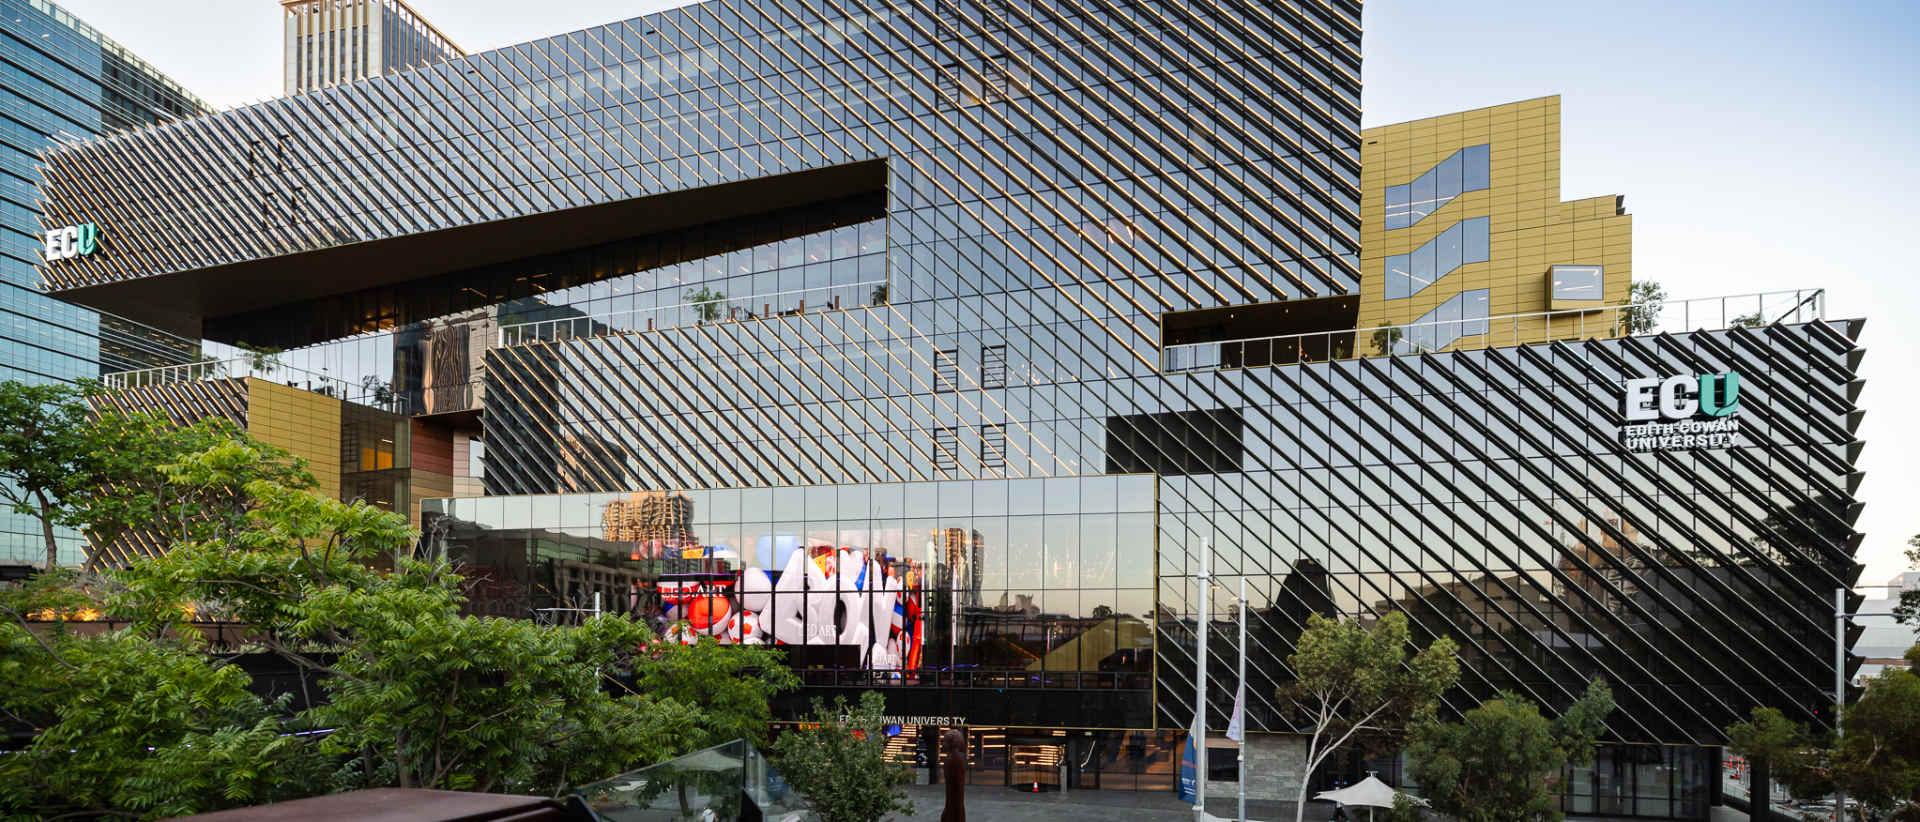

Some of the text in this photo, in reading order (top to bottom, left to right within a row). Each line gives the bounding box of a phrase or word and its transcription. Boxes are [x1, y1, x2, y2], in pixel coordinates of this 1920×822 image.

[47, 222, 96, 261] ECU
[1626, 371, 1739, 420] ECU
[1624, 419, 1739, 437] EDITH COWAN
[1624, 432, 1740, 450] UNIVERSITY
[906, 715, 967, 726] UNIVERSTY
